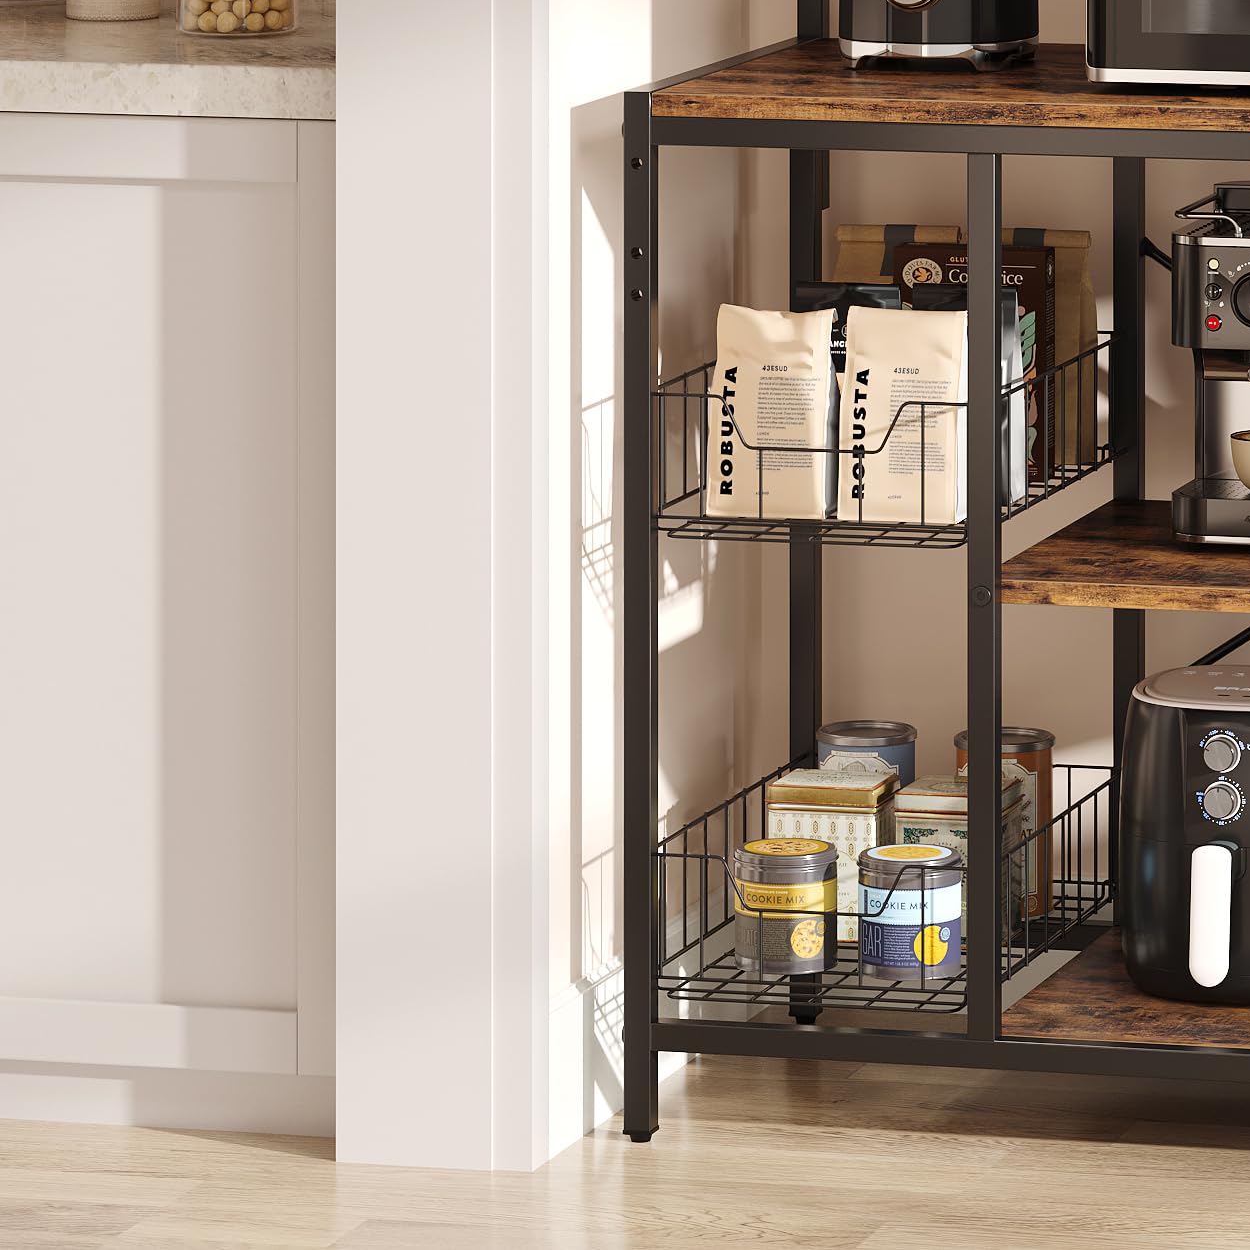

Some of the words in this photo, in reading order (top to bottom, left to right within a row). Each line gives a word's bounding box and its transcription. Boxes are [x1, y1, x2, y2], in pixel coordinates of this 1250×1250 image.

[948, 268, 968, 284] Co
[893, 367, 920, 375] 43ESUD
[719, 366, 738, 496] ROBUSTA
[851, 368, 870, 500] ROBUSTA
[746, 893, 783, 905] COOKIE
[785, 895, 806, 904] MIX
[869, 899, 906, 910] COOKIE
[862, 922, 882, 957] GAR
